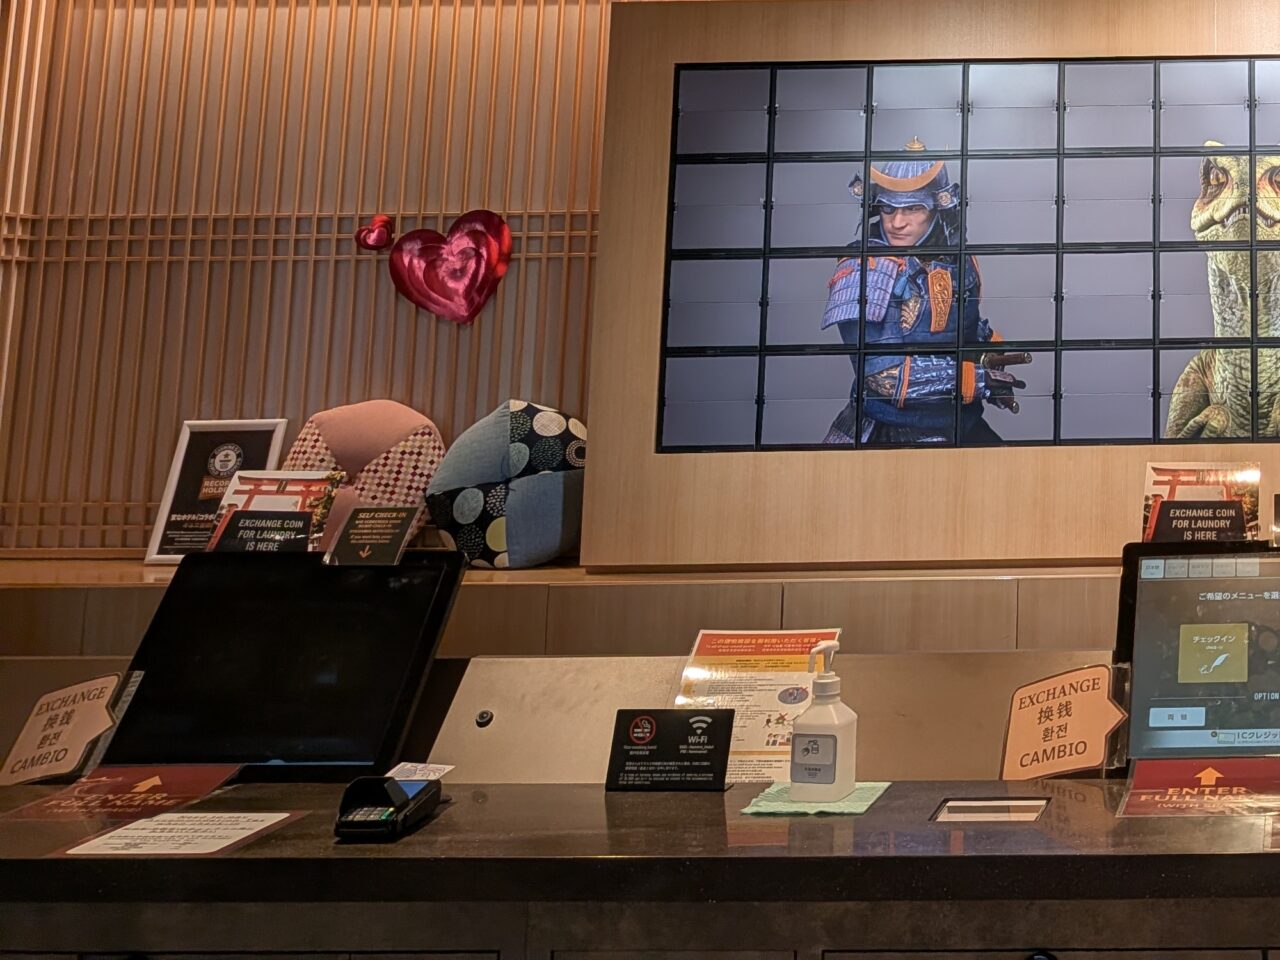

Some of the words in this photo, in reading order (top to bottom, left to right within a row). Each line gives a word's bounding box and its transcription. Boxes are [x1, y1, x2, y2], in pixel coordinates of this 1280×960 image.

[1169, 508, 1214, 518] EXCHANGE
[1215, 509, 1235, 517] COIN
[238, 519, 283, 528] EXCHANGE
[284, 519, 303, 528] COIN
[1172, 519, 1190, 529] FOR
[1191, 519, 1231, 529] LAUNDRY
[238, 530, 255, 539] FOR
[256, 530, 296, 539] LAUNDRY
[1184, 531, 1192, 540] IS
[1194, 531, 1217, 540] HERE
[245, 542, 254, 551] IS
[256, 542, 279, 551] HERE
[1193, 635, 1236, 644] チェックイン
[1018, 677, 1101, 710] EXCHANGE
[1254, 692, 1280, 701] OPTION
[35, 686, 108, 717] EXCHANGE
[1037, 700, 1073, 725] 换钱
[1041, 722, 1068, 743] 환전
[688, 736, 708, 744] Wi-Fi
[1019, 740, 1088, 768] CAMBIO
[10, 748, 69, 775] CAMBIO
[1167, 787, 1248, 795] ENTER
